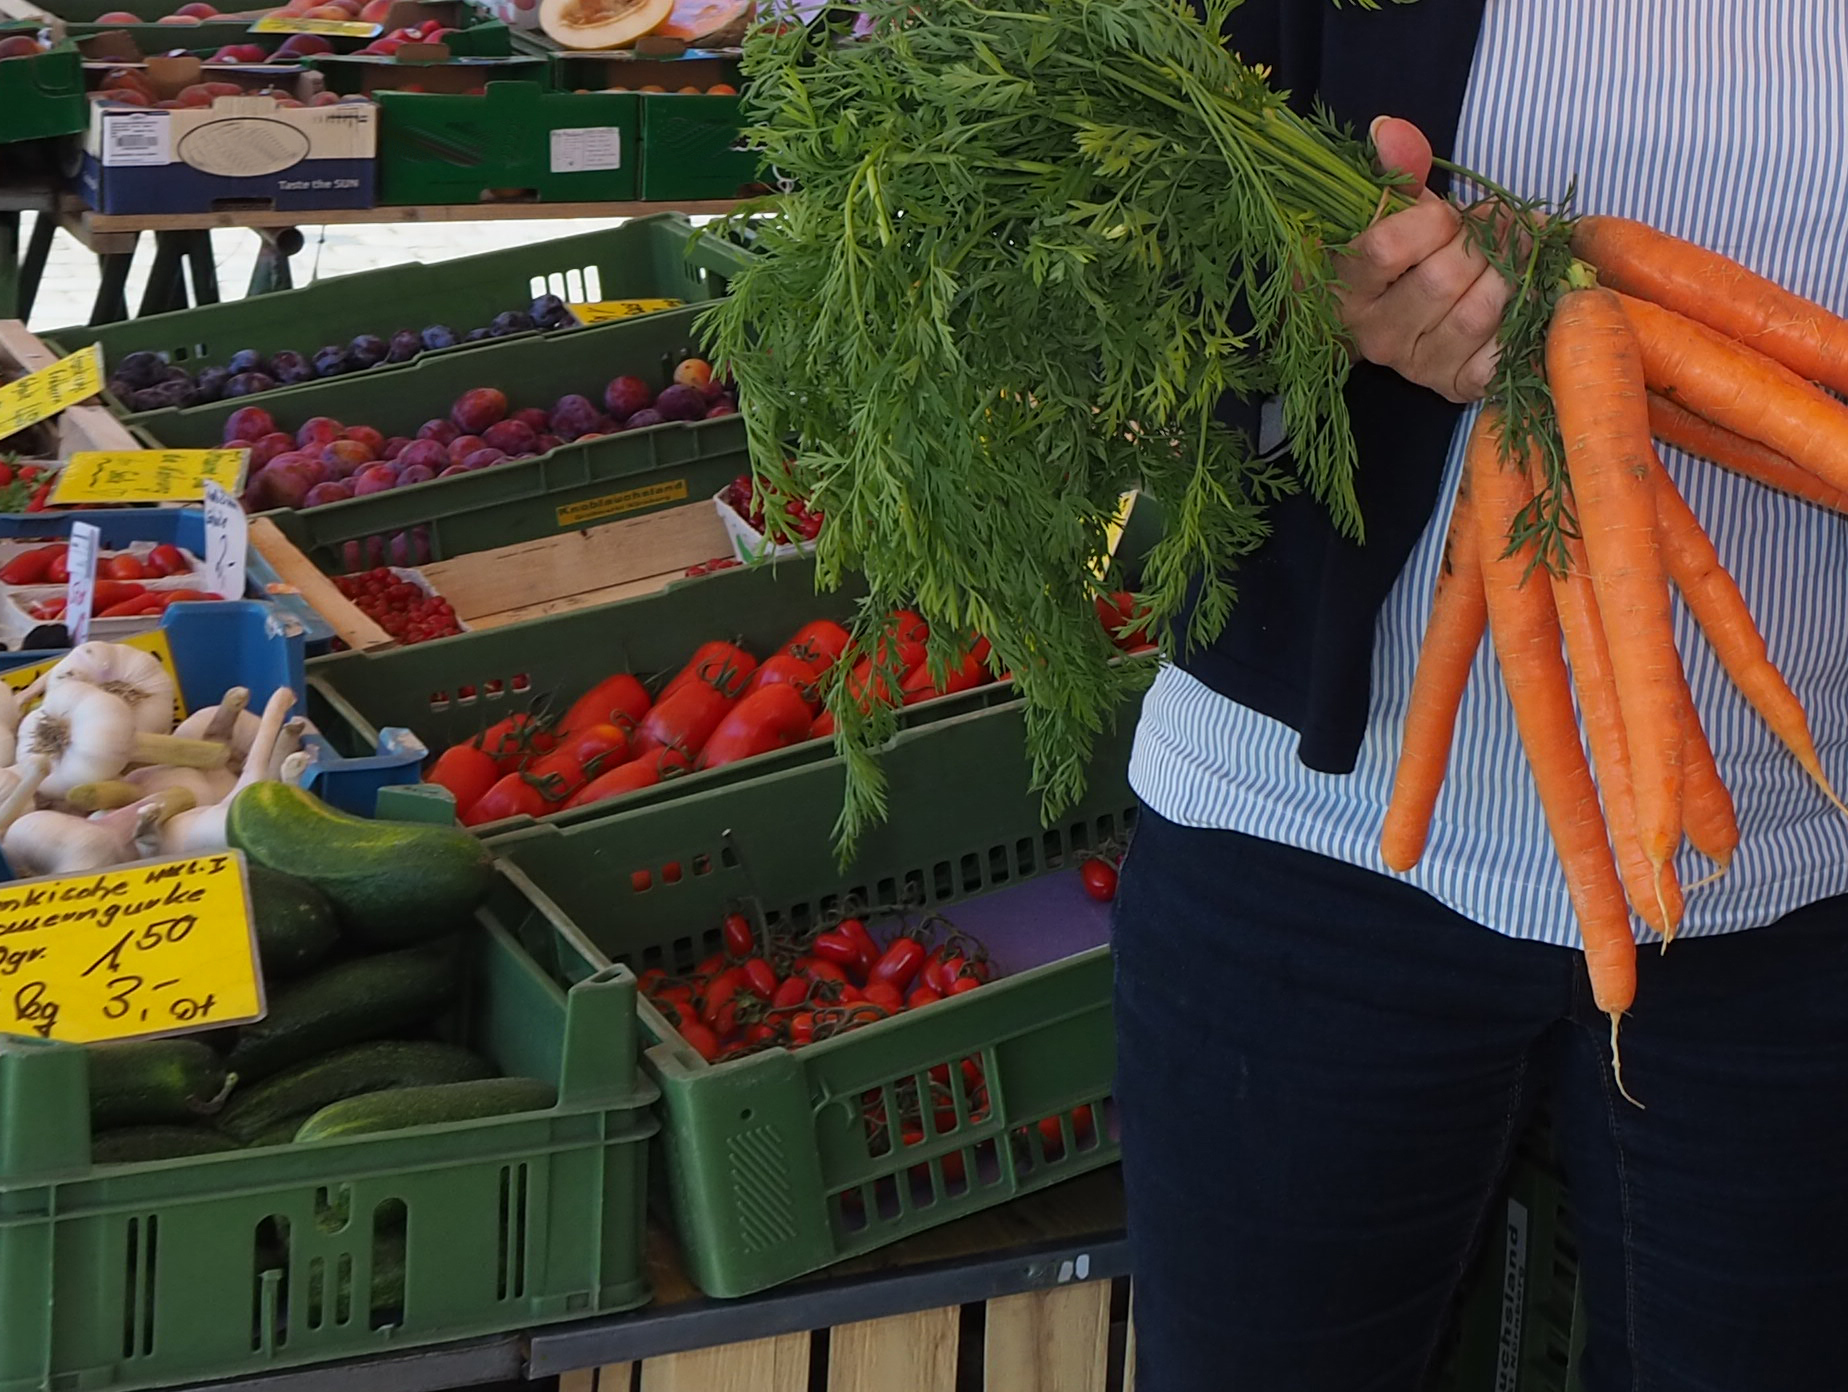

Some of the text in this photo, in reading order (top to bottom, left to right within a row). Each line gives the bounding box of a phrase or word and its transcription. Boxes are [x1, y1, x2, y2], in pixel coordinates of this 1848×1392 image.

[278, 180, 310, 191] Taste
[312, 179, 332, 190] the
[558, 480, 683, 516] Knoblauchsland
